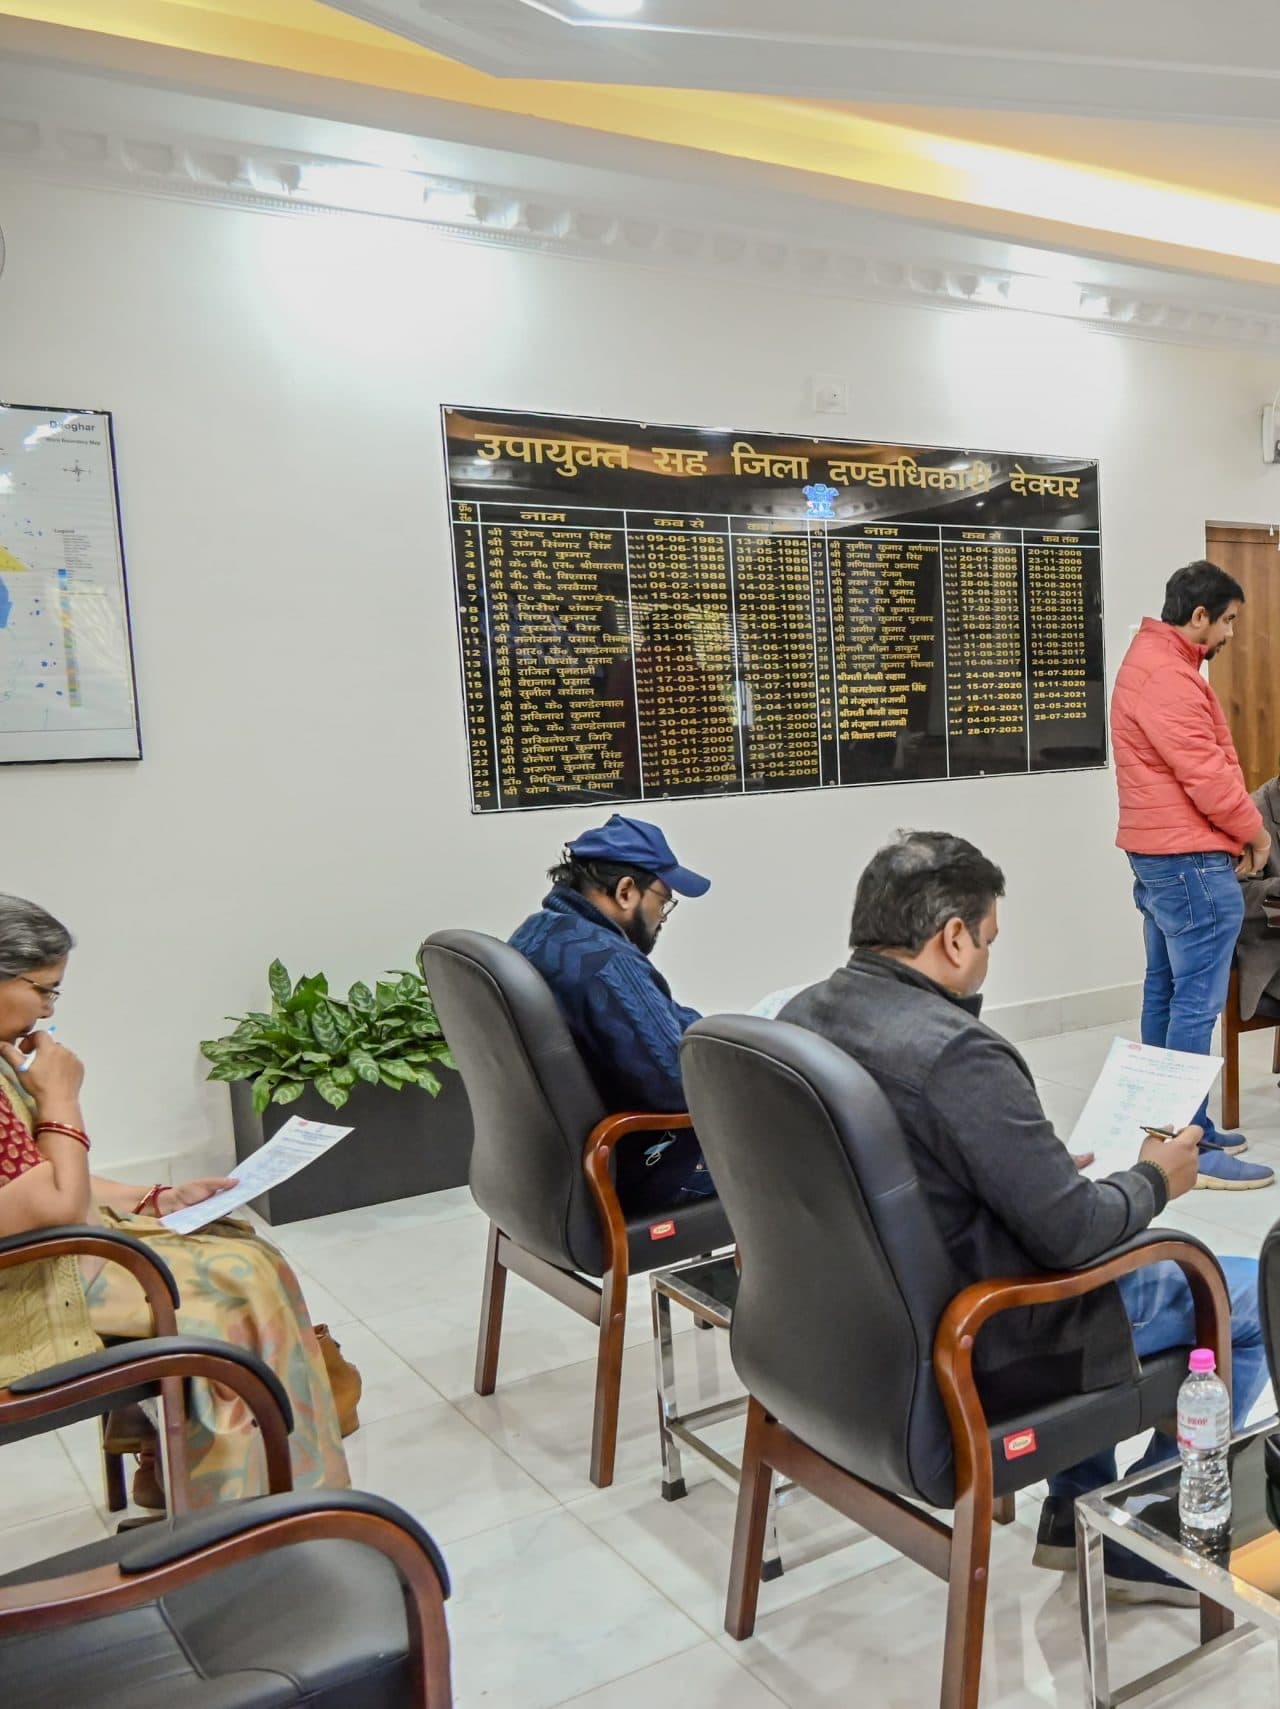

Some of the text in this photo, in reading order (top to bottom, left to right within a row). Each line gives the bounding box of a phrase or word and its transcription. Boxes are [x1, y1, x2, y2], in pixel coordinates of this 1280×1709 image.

[50, 420, 95, 431] Doghar
[474, 434, 630, 477] उपायुक्त
[652, 447, 708, 475] सह
[731, 441, 809, 480] जिला
[828, 455, 993, 493] दण्डाधिकारी
[520, 511, 565, 521] नाम
[689, 517, 704, 527] से
[864, 527, 898, 535] नाम
[657, 674, 731, 682] 17-03-1997
[657, 683, 732, 692] 30-09-1997
[570, 711, 600, 721] कुमार
[660, 735, 733, 745] 30-11-2000
[561, 753, 593, 763] कुमार
[563, 763, 595, 773] कुमार
[661, 754, 734, 765] 03-07-2003
[662, 773, 736, 785] 13-04-2005
